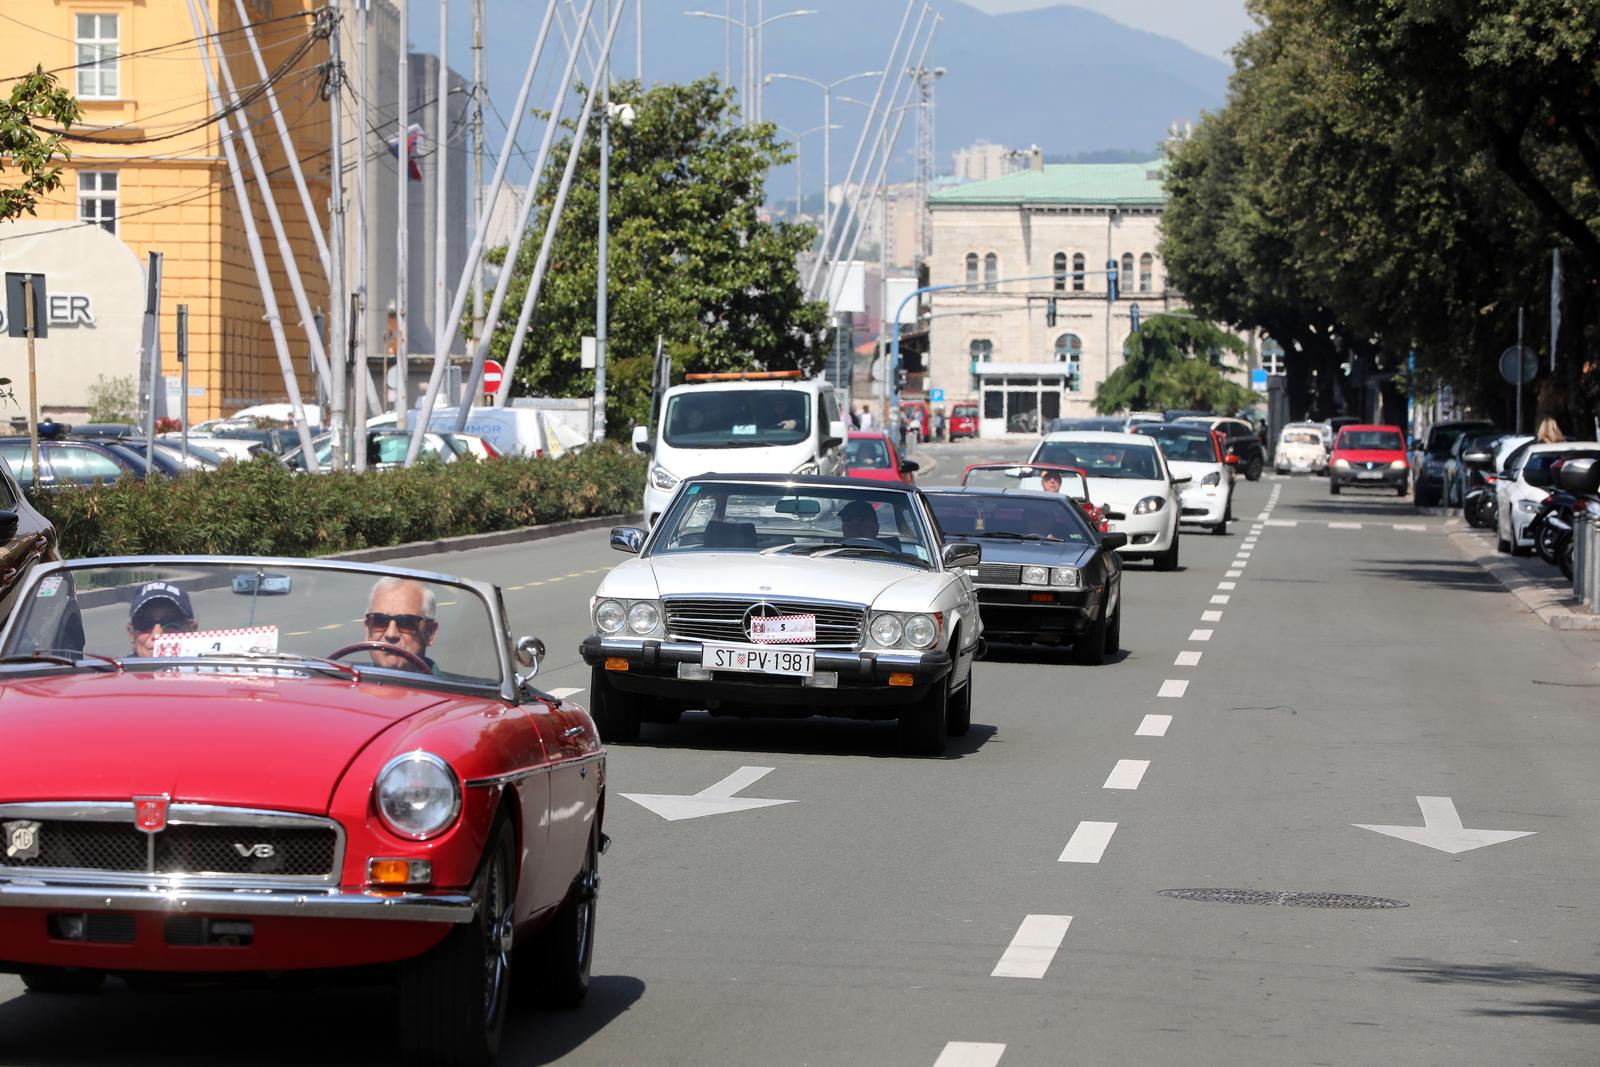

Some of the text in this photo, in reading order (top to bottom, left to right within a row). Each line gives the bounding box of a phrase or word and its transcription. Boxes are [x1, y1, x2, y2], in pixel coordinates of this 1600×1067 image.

[48, 296, 92, 320] ER
[780, 623, 785, 631] 5
[211, 641, 221, 652] 4
[715, 649, 735, 668] ST
[14, 830, 32, 848] MG
[234, 843, 275, 858] V8
